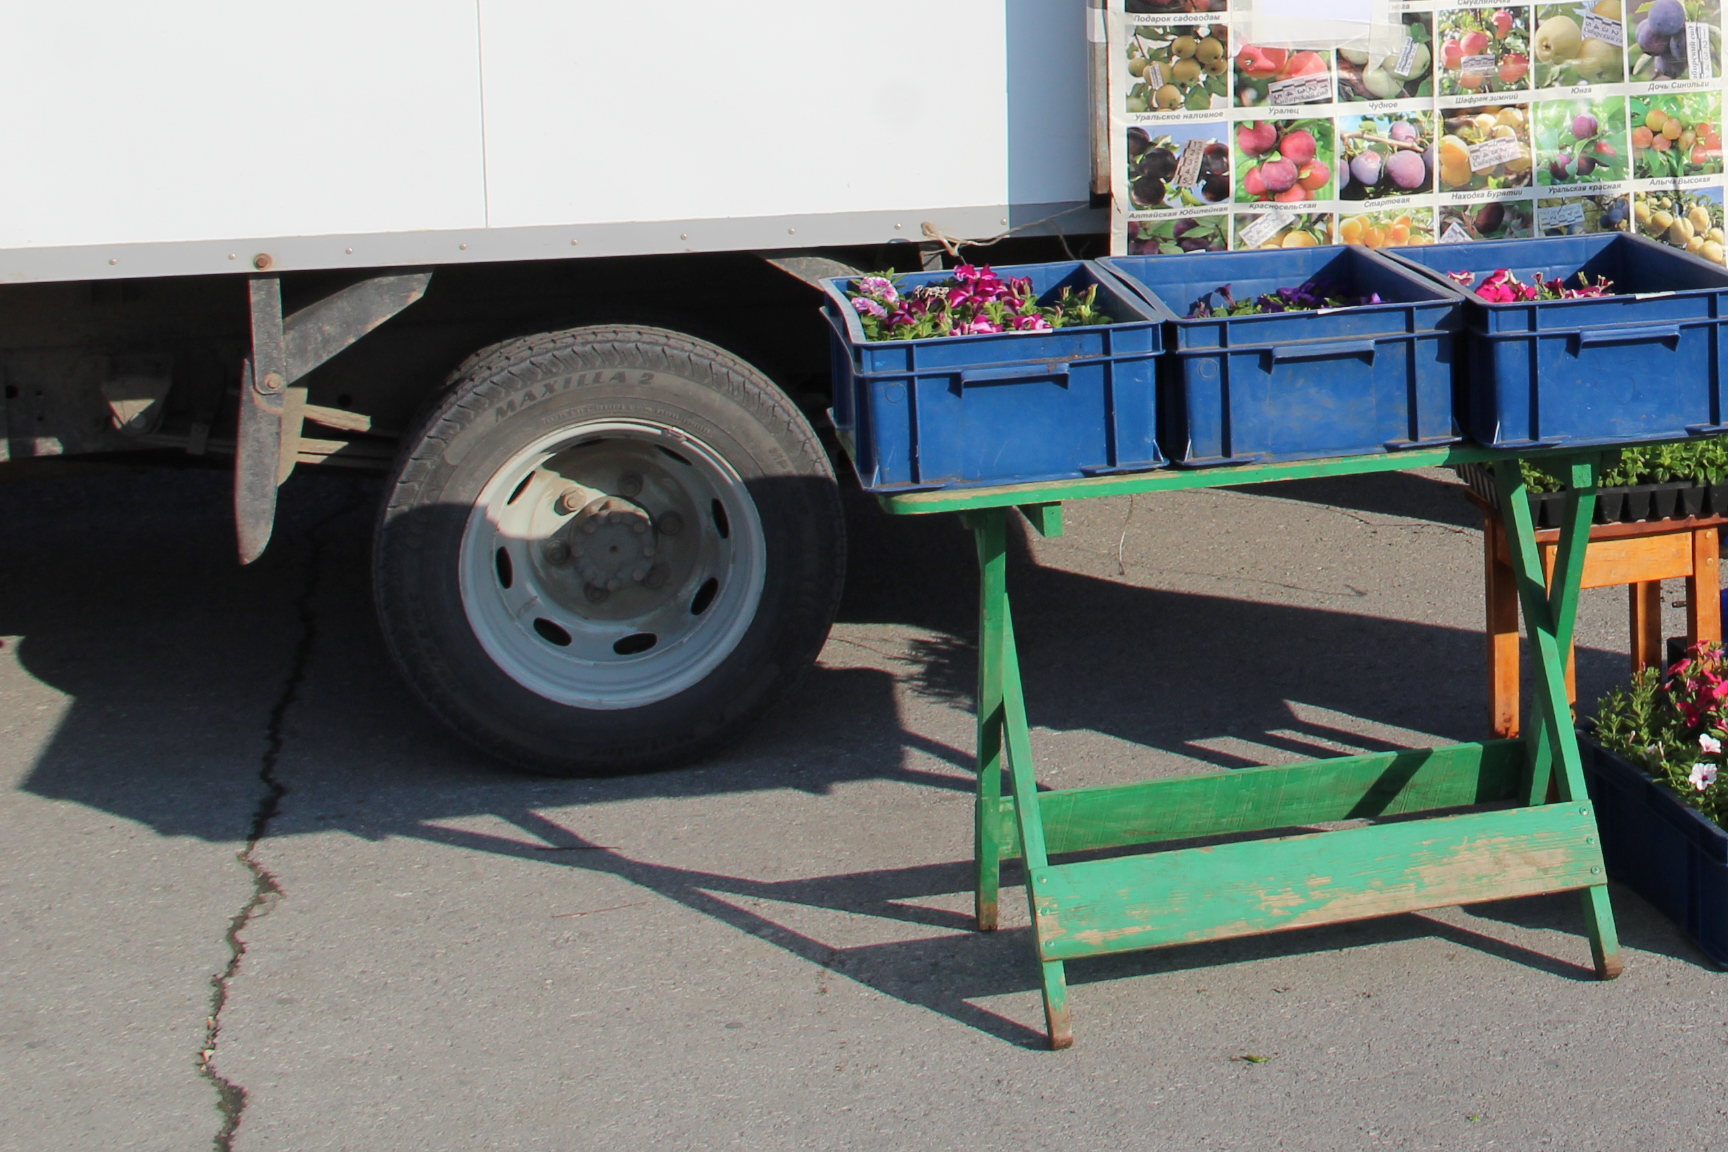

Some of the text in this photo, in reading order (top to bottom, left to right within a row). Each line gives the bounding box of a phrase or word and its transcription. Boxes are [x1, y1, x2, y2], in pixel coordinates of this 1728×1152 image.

[1133, 13, 1221, 24] Подарок садоводам
[1570, 86, 1592, 96] Юнга
[1647, 79, 1710, 92] Дочь Синильги
[1455, 92, 1518, 104] Шафран зимний
[1268, 105, 1300, 116] Уралец
[1368, 100, 1398, 111] Чудное
[1134, 110, 1224, 123] Уральское наливное
[1649, 175, 1711, 188] Алыча Высокая
[1451, 188, 1523, 201] Находка Бурятии
[1548, 183, 1622, 195] Уральская красная
[1249, 201, 1317, 211] Красносельская
[1364, 197, 1411, 208] Стартовая
[1129, 206, 1229, 219] Алтайская Юбилейная
[495, 370, 627, 423] MAXILLA
[638, 373, 655, 385] 2
